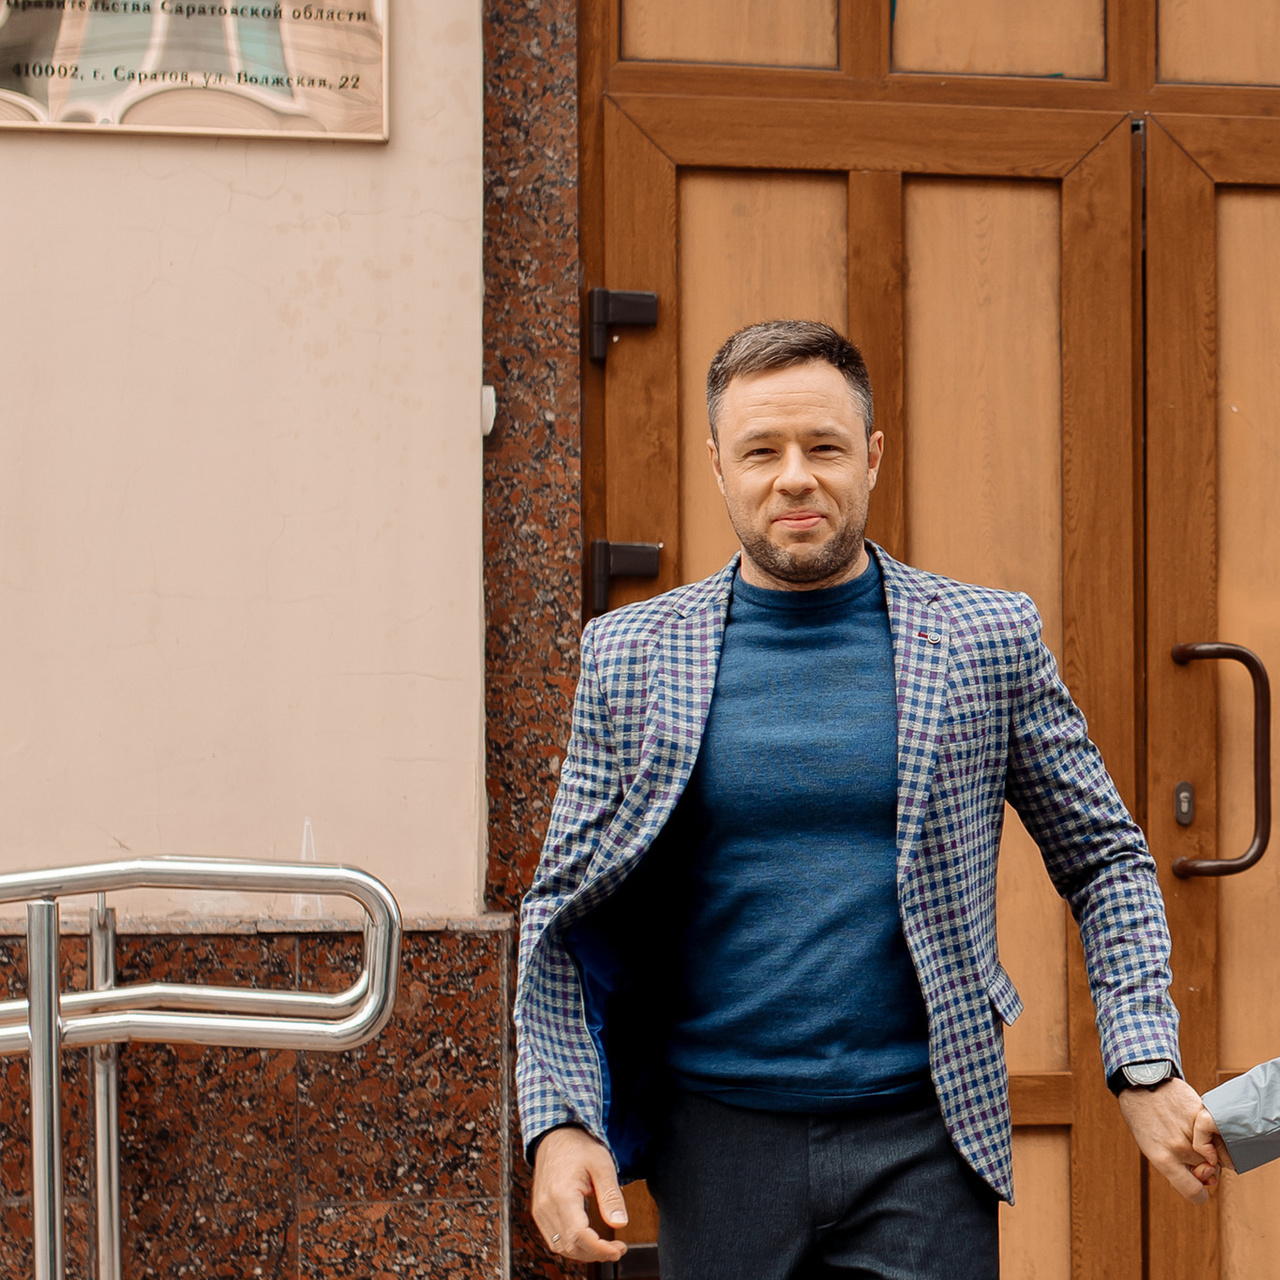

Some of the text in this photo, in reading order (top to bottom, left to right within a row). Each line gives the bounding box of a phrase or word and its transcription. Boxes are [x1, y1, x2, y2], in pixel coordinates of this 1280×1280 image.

[292, 4, 367, 22] области
[12, 63, 360, 90] 410002, г. Саратов, ул. Волжская, 22
